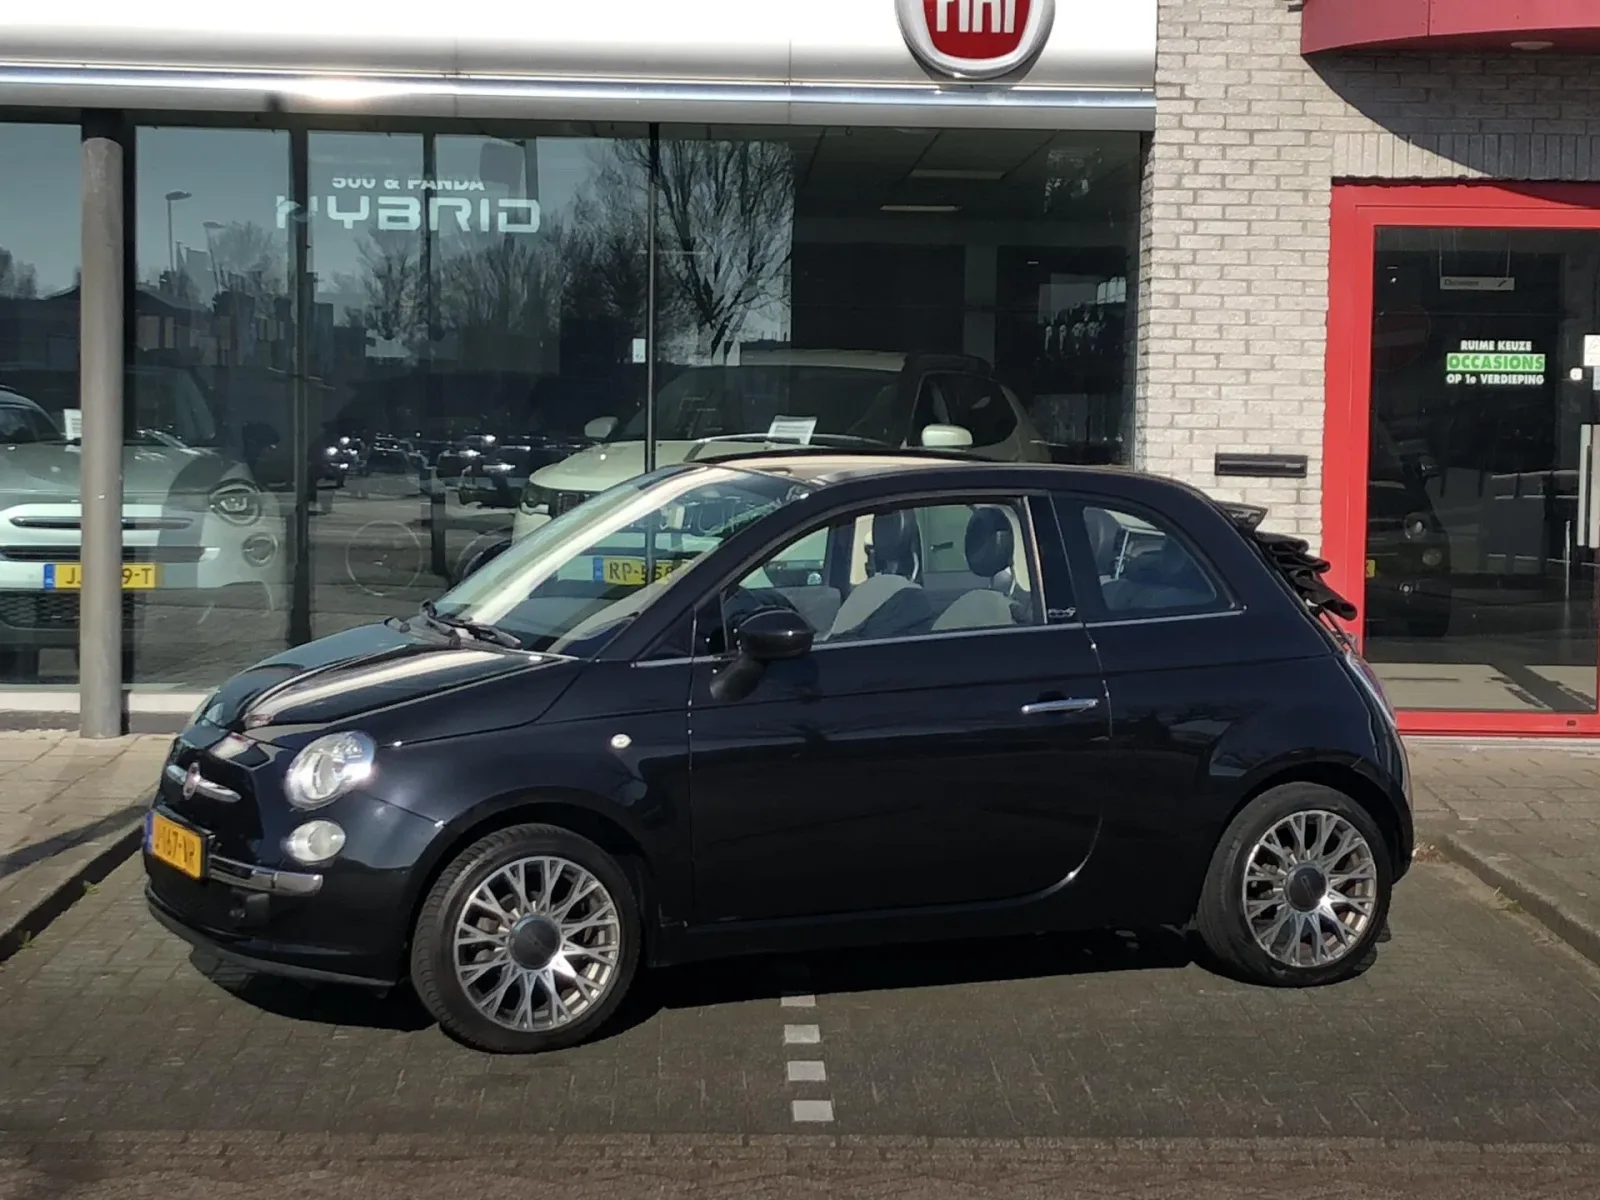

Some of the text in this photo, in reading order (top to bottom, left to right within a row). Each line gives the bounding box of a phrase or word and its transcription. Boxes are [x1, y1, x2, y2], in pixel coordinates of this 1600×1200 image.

[1460, 340, 1532, 351] RUIME KEUZE
[1448, 354, 1544, 370] OCCASIONS
[1446, 374, 1462, 384] OP
[1480, 374, 1545, 385] VERDIEPING
